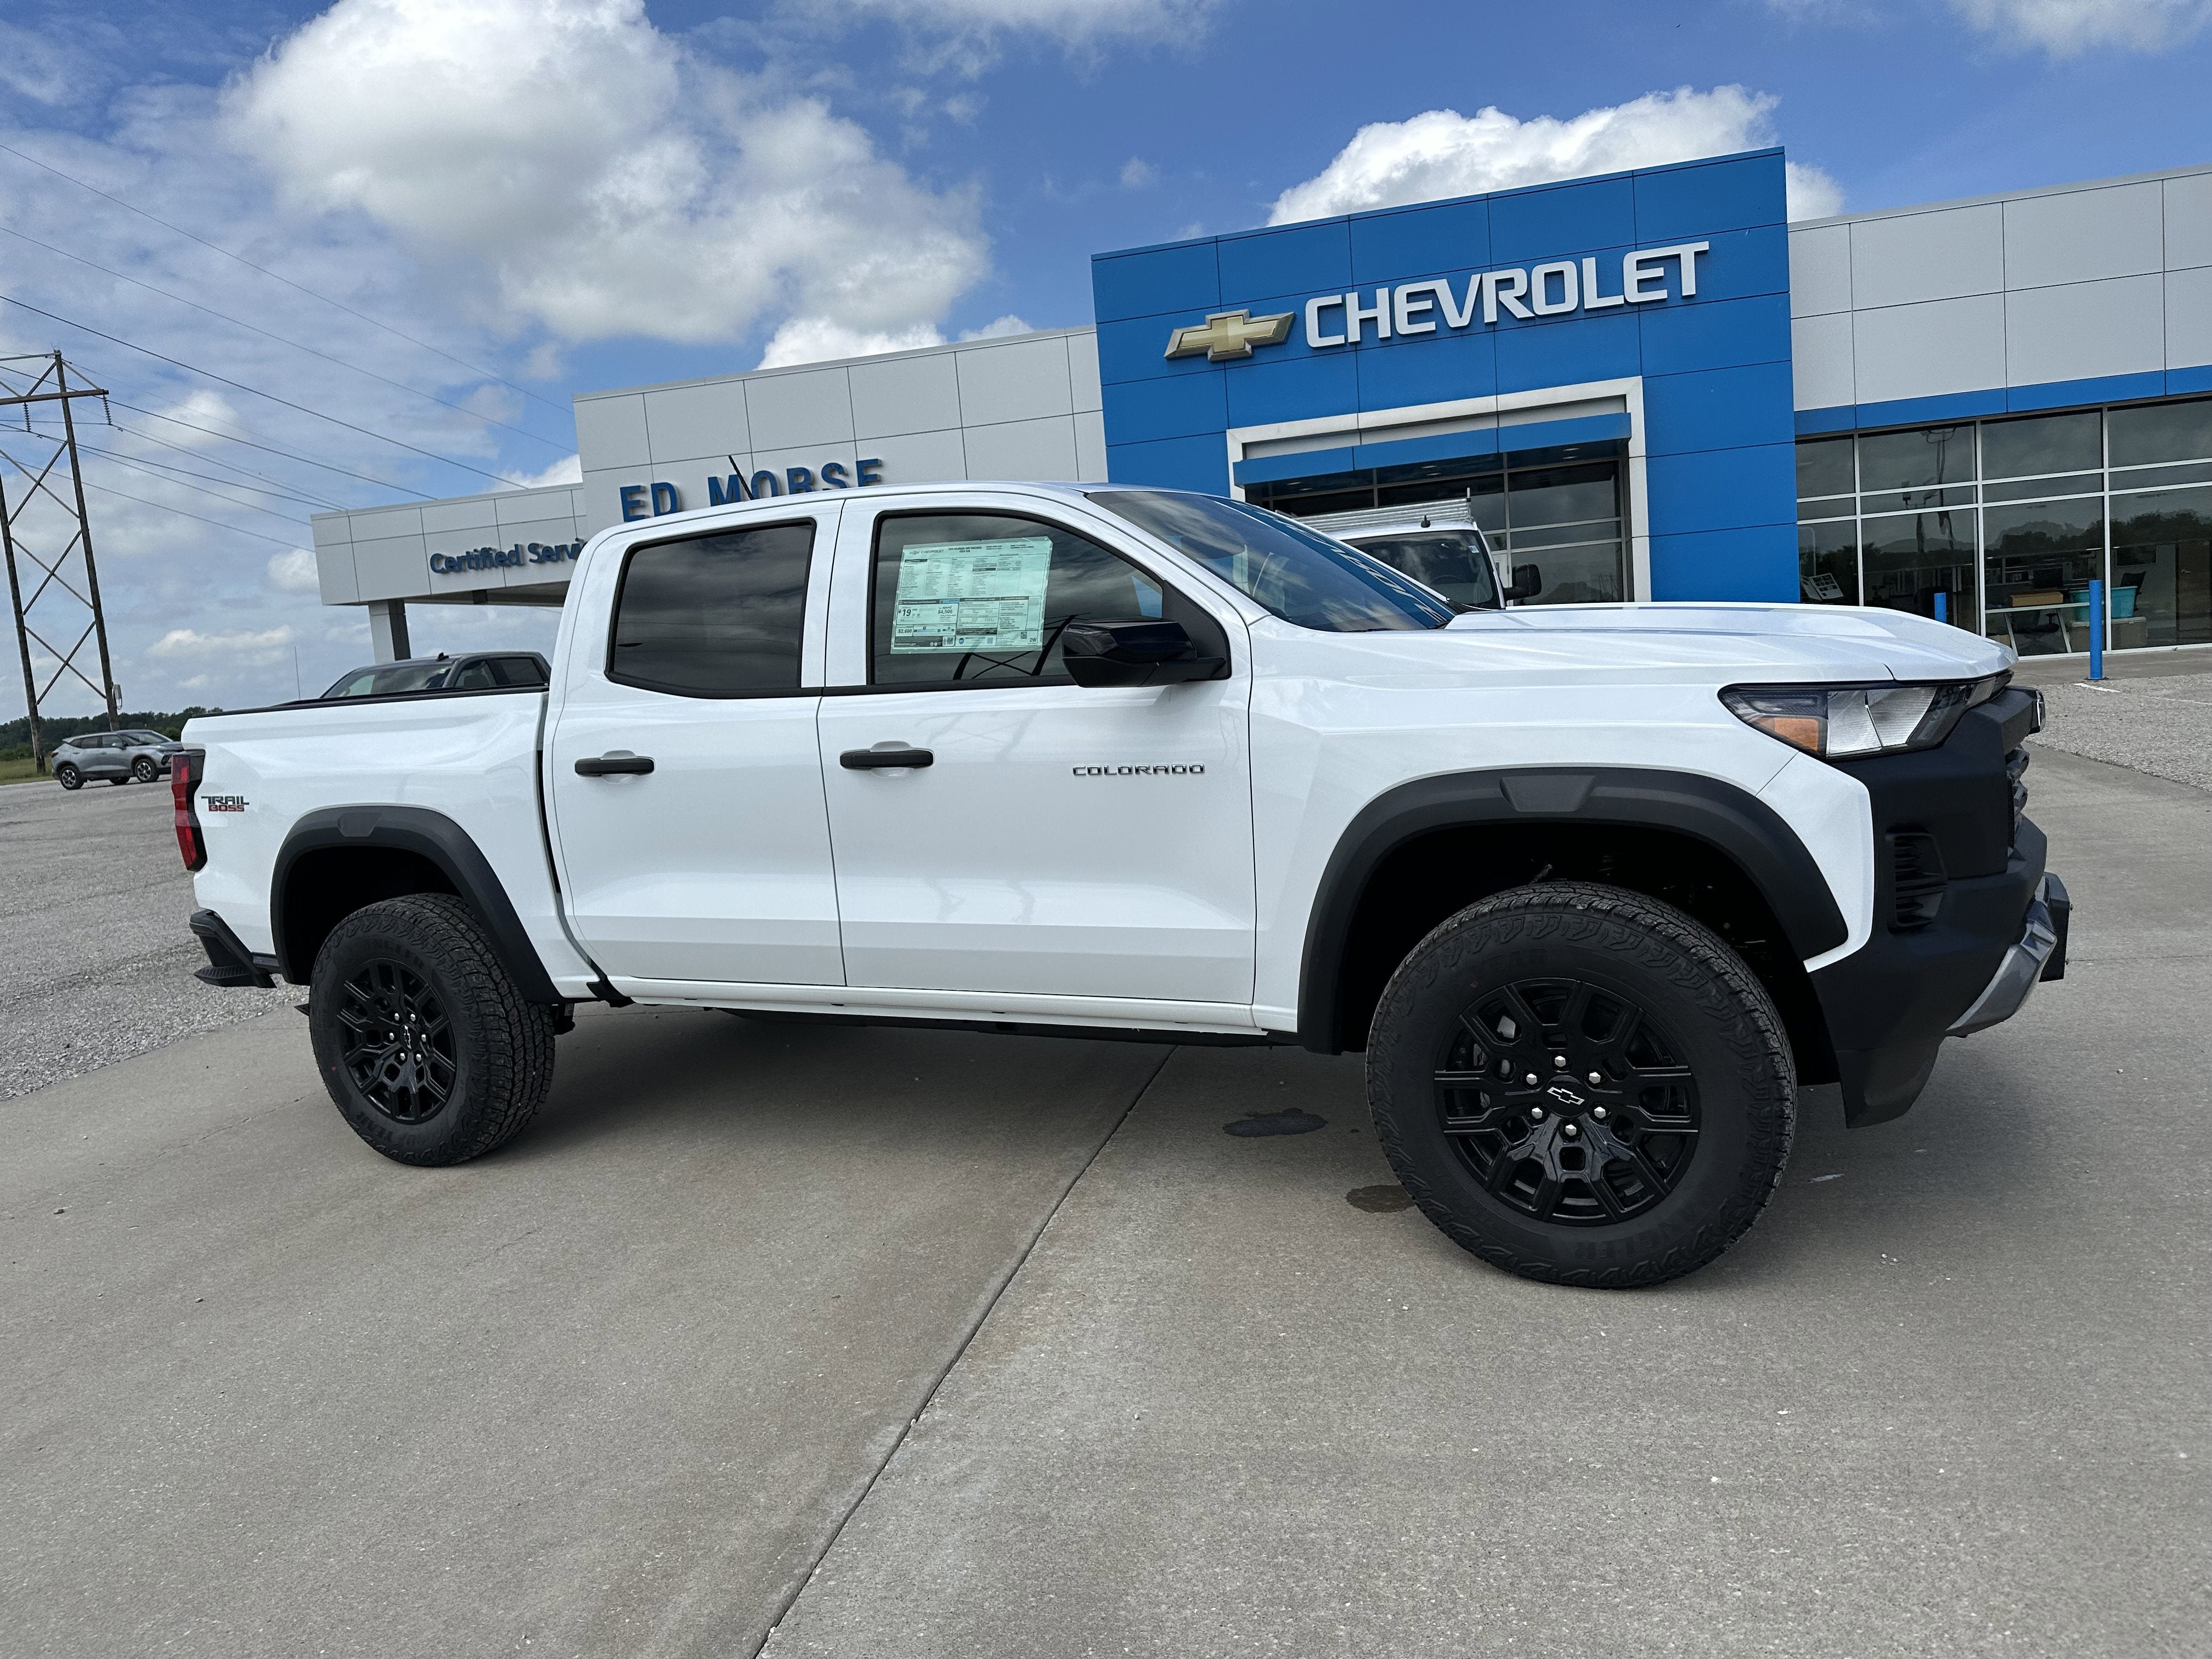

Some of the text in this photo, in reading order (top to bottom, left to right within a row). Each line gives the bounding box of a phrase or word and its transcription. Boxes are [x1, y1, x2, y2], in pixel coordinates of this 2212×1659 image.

[1305, 240, 1709, 348] CHEVROLET
[619, 458, 882, 523] ED MORSE
[430, 538, 588, 573] Certified Servi
[902, 608, 911, 617] 19
[1073, 763, 1205, 776] COLORADO
[201, 795, 250, 805] TRAIL
